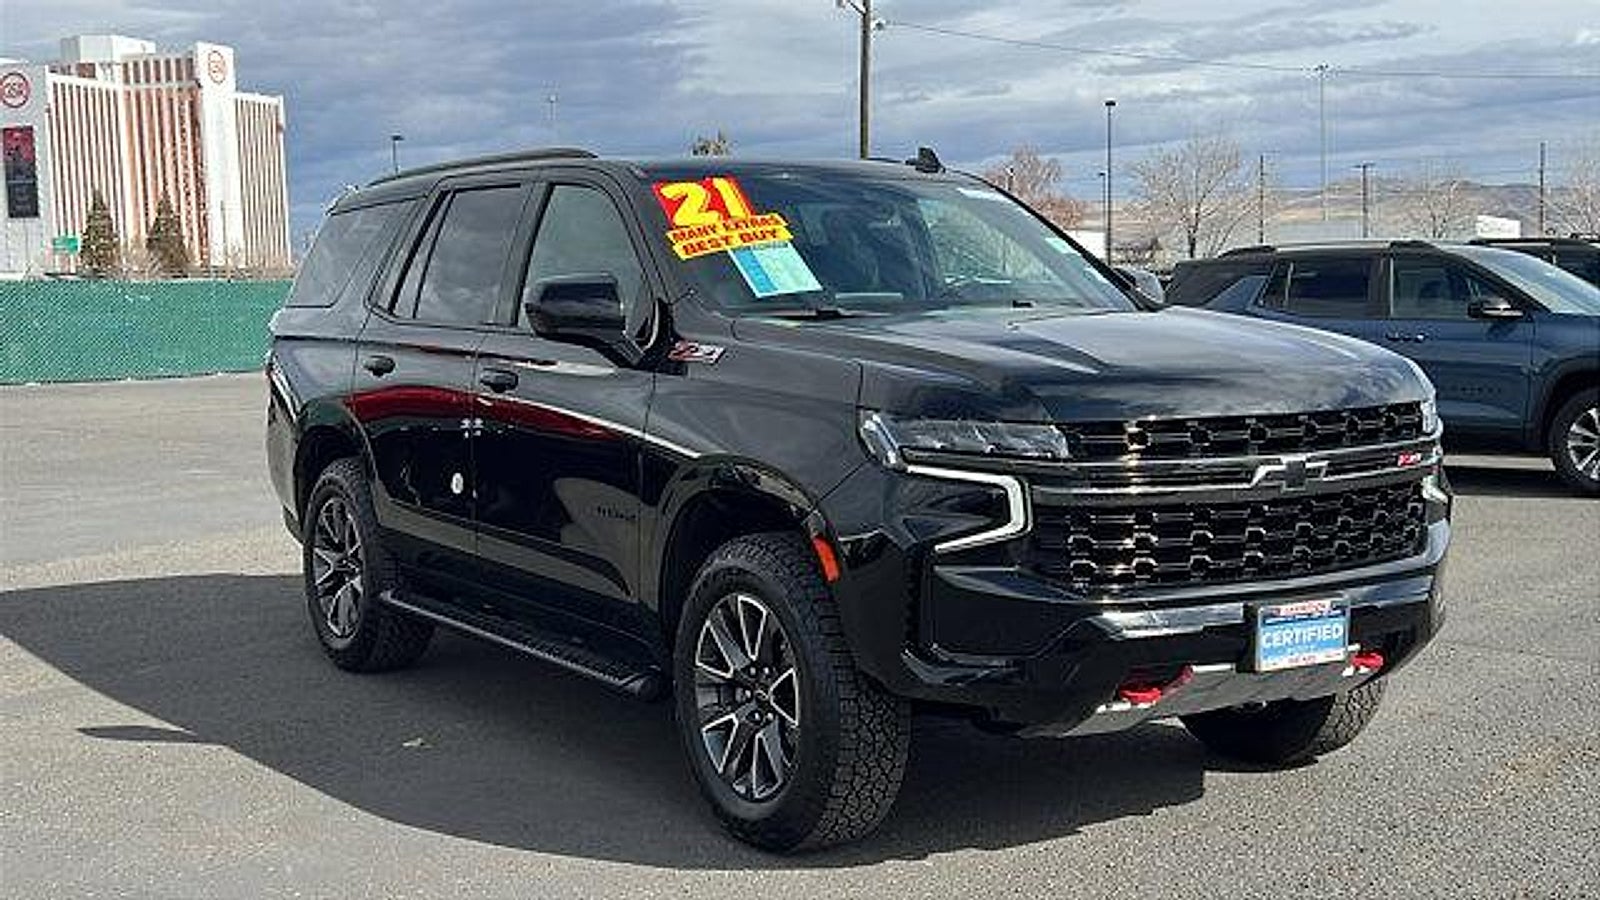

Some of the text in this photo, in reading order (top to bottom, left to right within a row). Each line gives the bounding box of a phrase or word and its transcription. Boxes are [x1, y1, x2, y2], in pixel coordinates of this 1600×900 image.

[660, 177, 751, 226] 21
[672, 224, 717, 243] MANY
[682, 235, 735, 256] BEST
[738, 229, 779, 244] BUY
[1261, 622, 1344, 647] CERTIFIED
